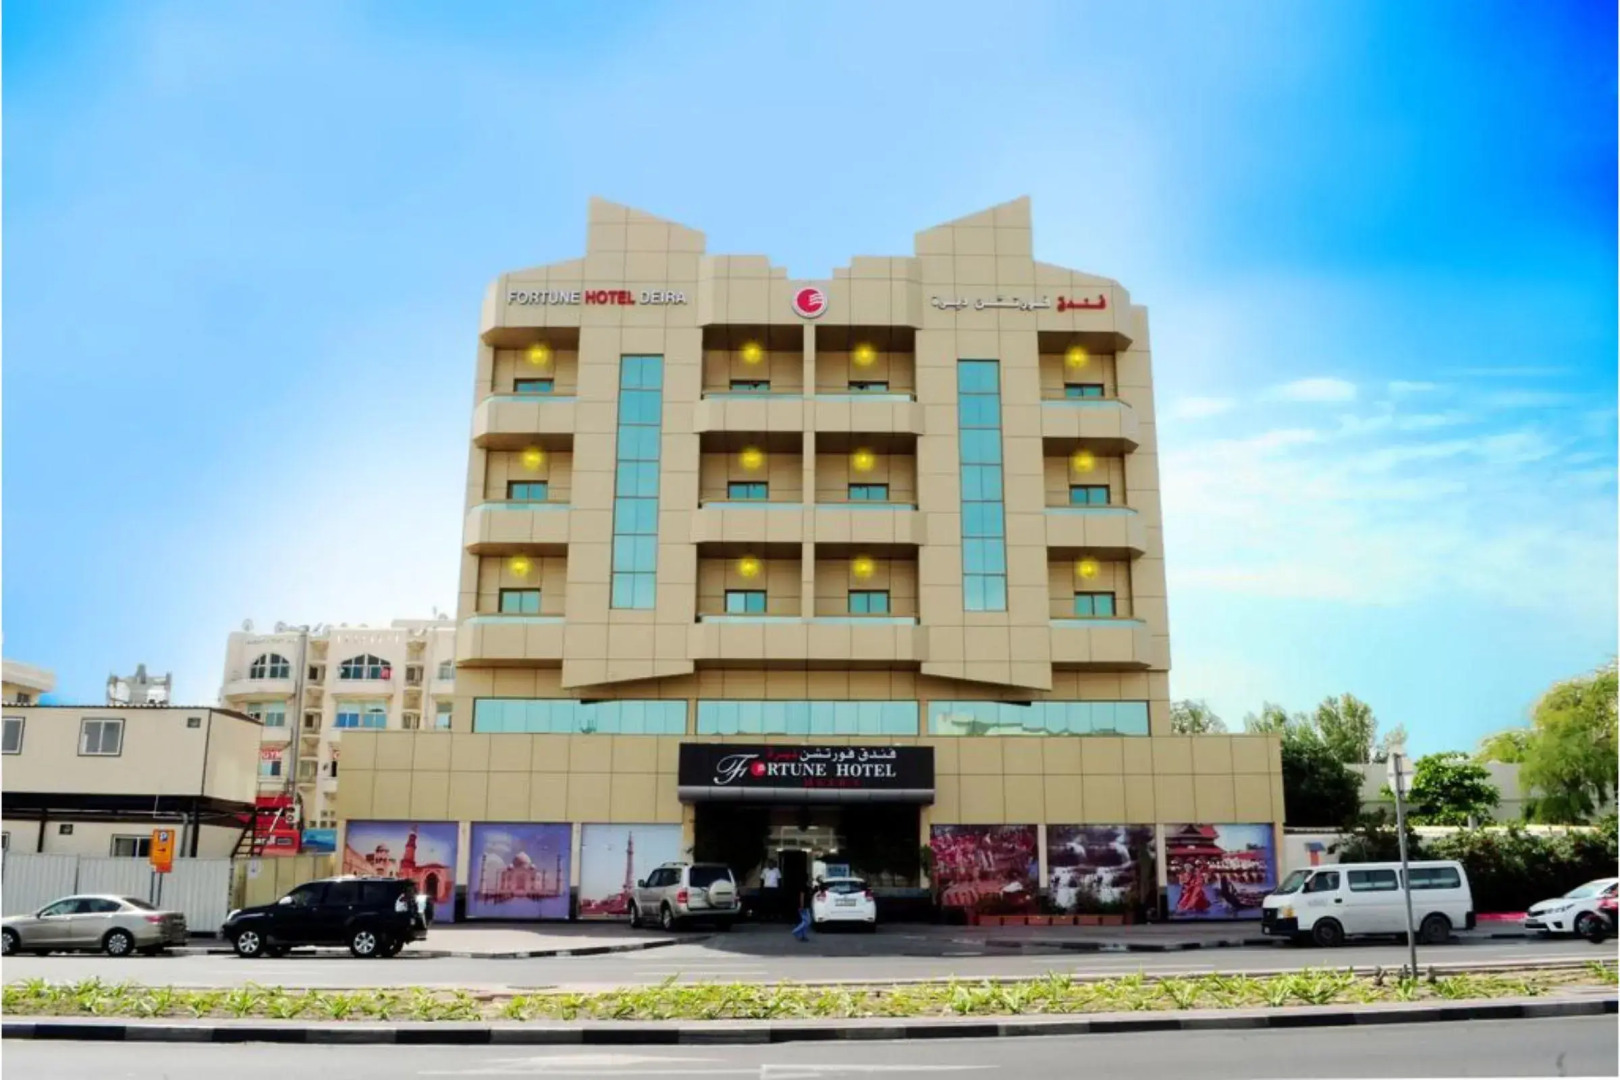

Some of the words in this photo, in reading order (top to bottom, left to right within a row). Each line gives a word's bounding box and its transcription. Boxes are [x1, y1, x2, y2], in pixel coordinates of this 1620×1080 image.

[508, 290, 581, 306] FORTUNE
[585, 290, 635, 306] HOTEL
[640, 290, 687, 306] DEIRA
[1057, 294, 1107, 313] فندق
[799, 748, 855, 761] فورتشن
[858, 747, 897, 761] فندق
[836, 763, 896, 777] HOTEL
